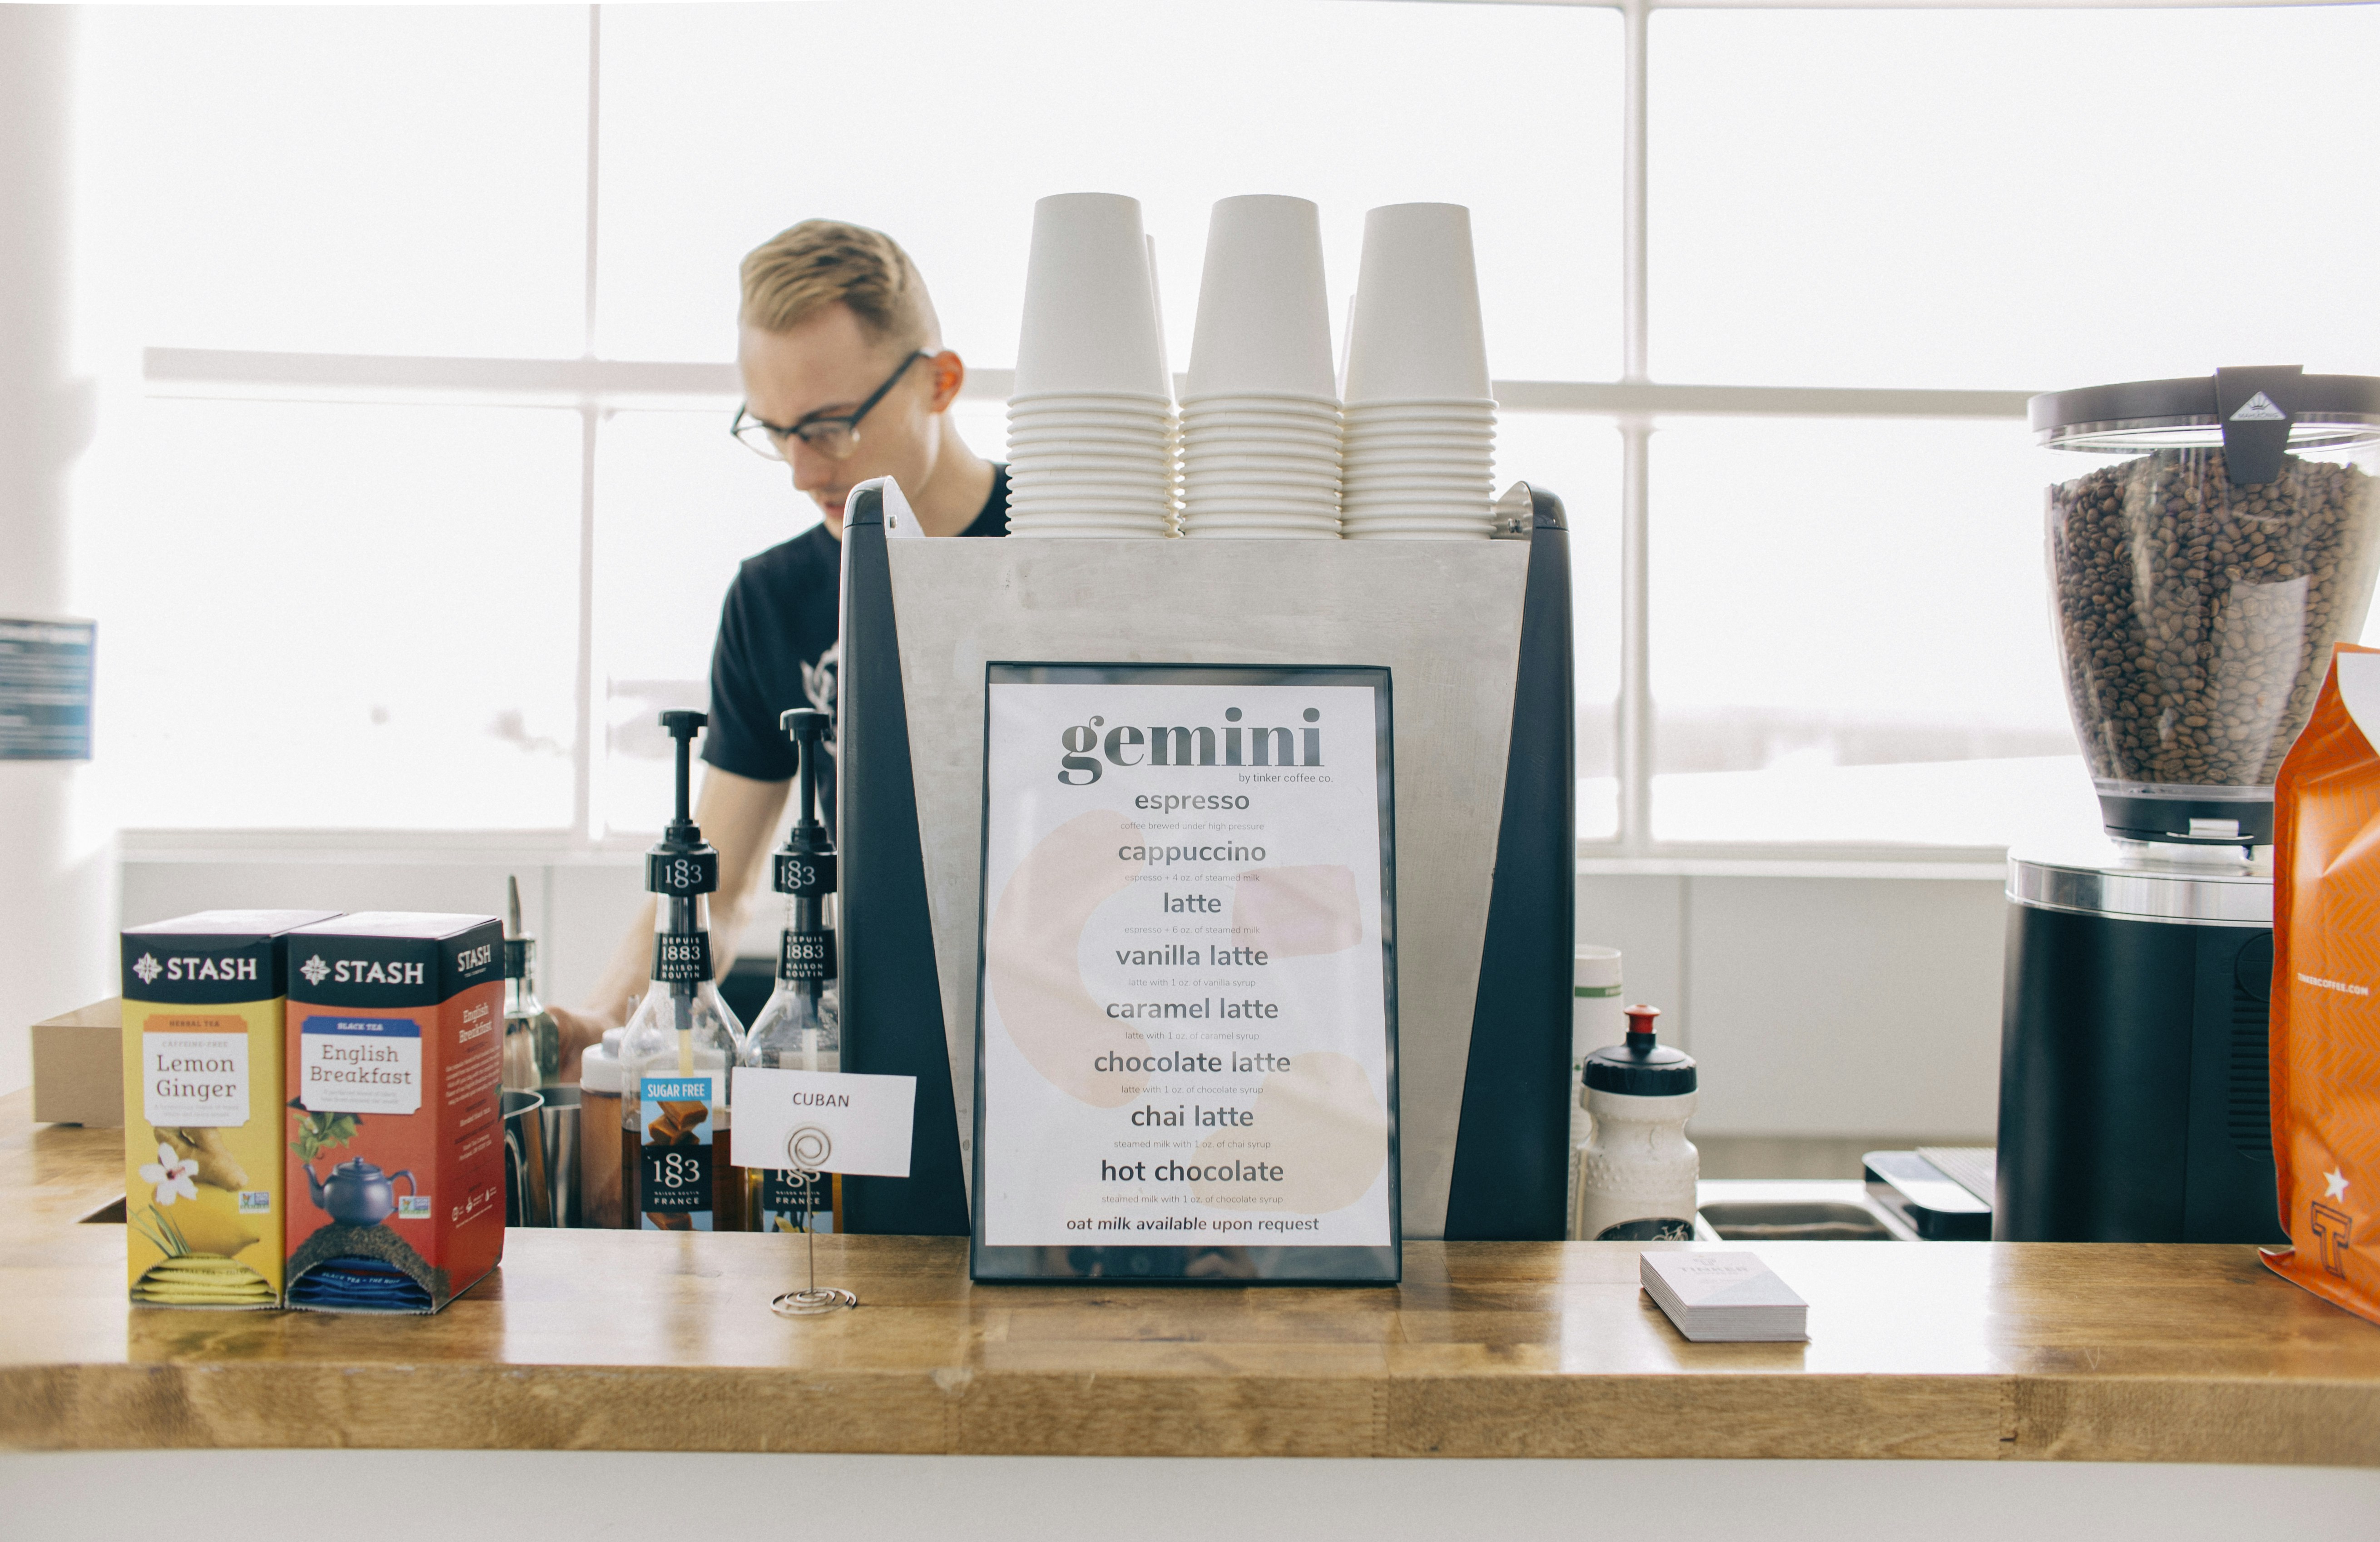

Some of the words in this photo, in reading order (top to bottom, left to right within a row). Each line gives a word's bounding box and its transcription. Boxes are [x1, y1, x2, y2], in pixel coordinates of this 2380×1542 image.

[1057, 707, 1325, 786] gemini
[1239, 773, 1251, 784] by
[1253, 773, 1281, 783] tinker
[1284, 773, 1316, 783] coffee
[1134, 794, 1250, 814] espresso
[1120, 822, 1146, 830] coffee
[1208, 823, 1226, 831] high
[1118, 840, 1266, 866] cappuccino
[1205, 873, 1241, 882] steamed
[1243, 873, 1260, 882] milk
[1164, 892, 1222, 913] latte
[662, 937, 700, 945] DEPUIS
[786, 935, 823, 943] DEPUIS
[457, 944, 491, 972] STASH
[662, 946, 700, 961] 1883
[786, 944, 824, 959] 1883
[1115, 944, 1200, 966] vanilla
[1210, 944, 1269, 966] latte
[167, 957, 257, 981] STASH
[334, 960, 424, 985] STASH
[1129, 978, 1147, 986] latte
[1172, 978, 1175, 987] 1
[463, 1002, 490, 1024] English
[1106, 997, 1210, 1019] caramel
[1220, 997, 1279, 1019] latte
[337, 1022, 365, 1031] BLACK
[365, 1023, 384, 1031] TEA
[459, 1020, 492, 1044] Breakfast
[1125, 1031, 1144, 1040] latte
[1146, 1031, 1165, 1040] with
[1168, 1031, 1172, 1040] 1
[1190, 1031, 1198, 1040] of
[1200, 1031, 1234, 1040] caramel
[157, 1054, 235, 1072] Lemon
[322, 1044, 399, 1064] English
[1094, 1050, 1222, 1073] chocolate
[1232, 1051, 1291, 1073] latte
[310, 1066, 412, 1085] Breakfast
[156, 1079, 237, 1102] Ginger
[647, 1083, 680, 1098] SUGAR
[682, 1083, 705, 1097] FREE
[1121, 1085, 1140, 1094] latte
[793, 1092, 850, 1107] CUBAN
[1130, 1104, 1185, 1127] chai
[1195, 1104, 1254, 1127] latte
[1114, 1140, 1151, 1148] steamed
[1195, 1140, 1199, 1148] 1
[1216, 1140, 1225, 1148] of
[1227, 1140, 1245, 1148] chai
[1247, 1141, 1271, 1150] syrup
[1101, 1159, 1146, 1182] hot
[1154, 1159, 1284, 1182] chocolate
[1101, 1195, 1139, 1203] steamed
[1184, 1195, 1187, 1203] 1
[1216, 1195, 1257, 1204] chocolate
[1259, 1196, 1284, 1205] syrup
[1066, 1217, 1093, 1230] oat
[1097, 1216, 1131, 1230] milk
[1136, 1216, 1207, 1230] available
[1212, 1220, 1253, 1233] upon
[1258, 1218, 1319, 1234] request
[2311, 1200, 2352, 1280] T
